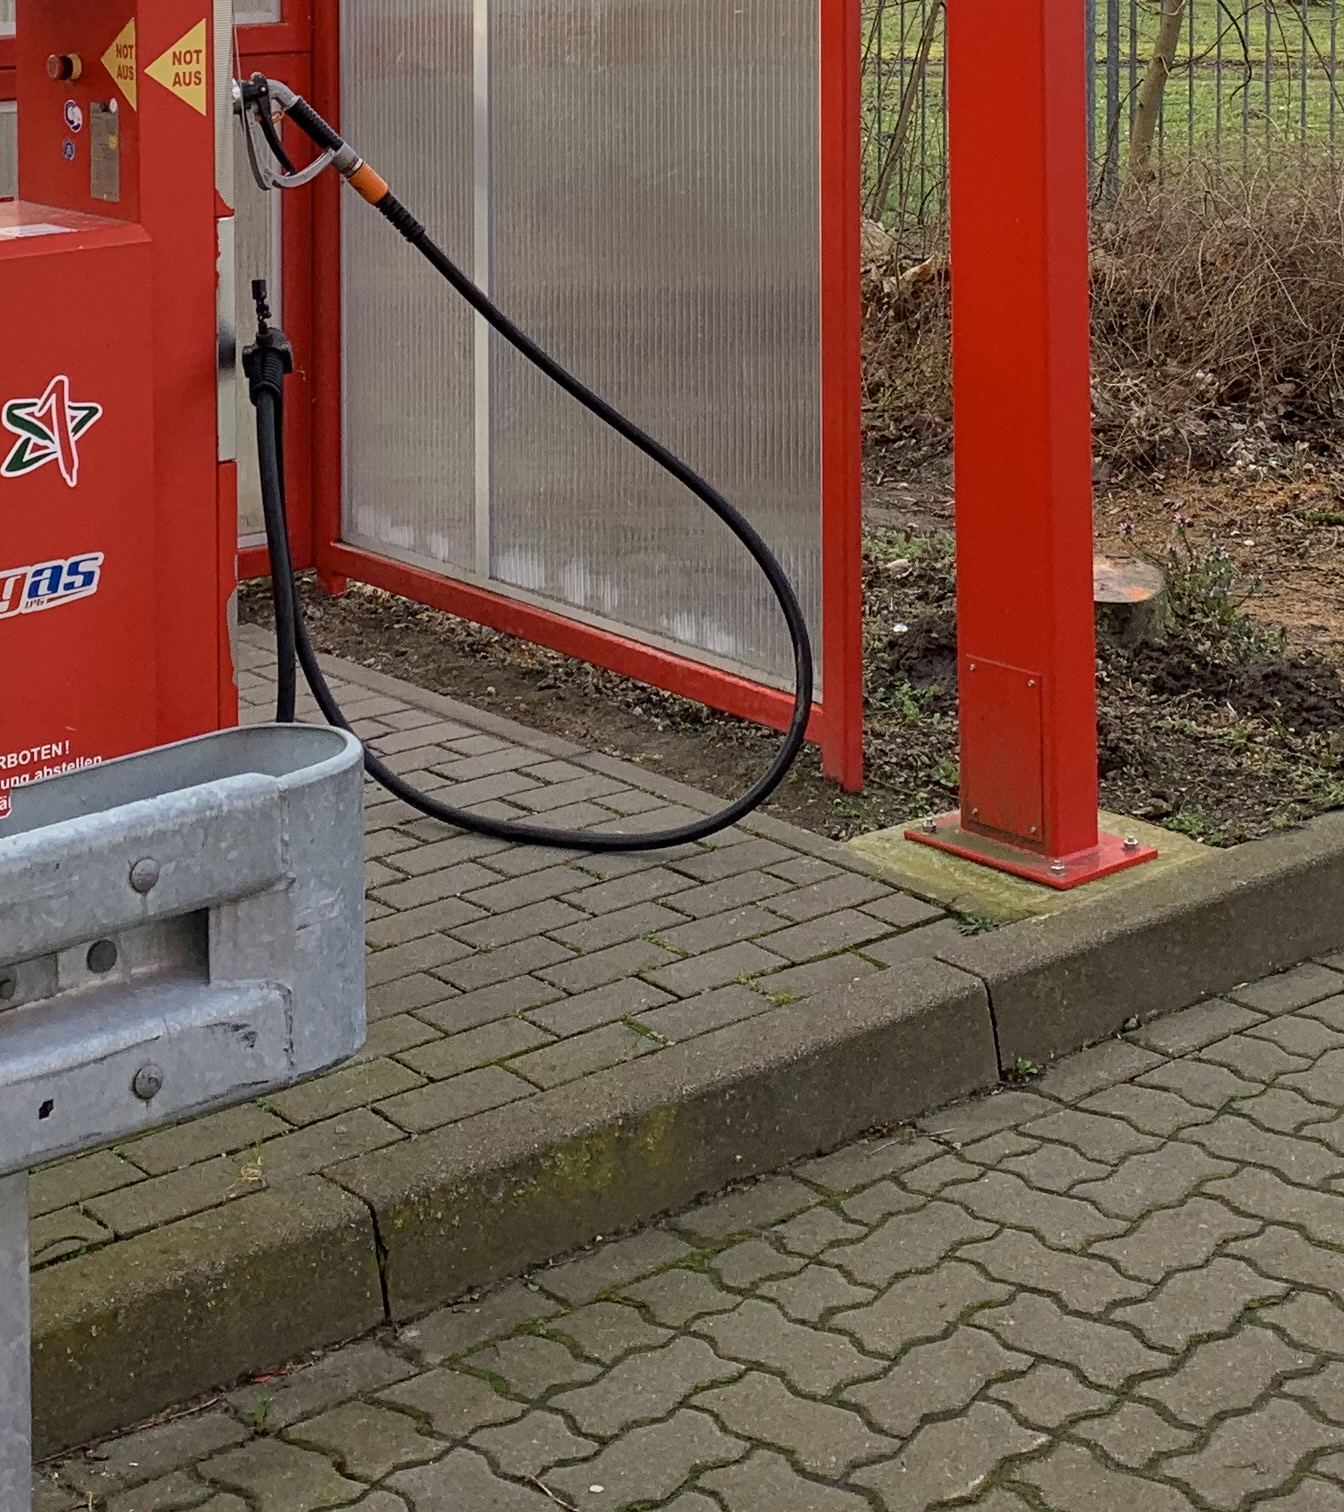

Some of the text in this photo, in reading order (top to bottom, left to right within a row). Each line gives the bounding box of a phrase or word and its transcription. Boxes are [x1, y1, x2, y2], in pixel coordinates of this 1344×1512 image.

[115, 43, 134, 60] NOT
[172, 49, 203, 66] NOT
[116, 64, 134, 81] AUS
[172, 70, 202, 88] AUS
[34, 755, 103, 781] abstellen
